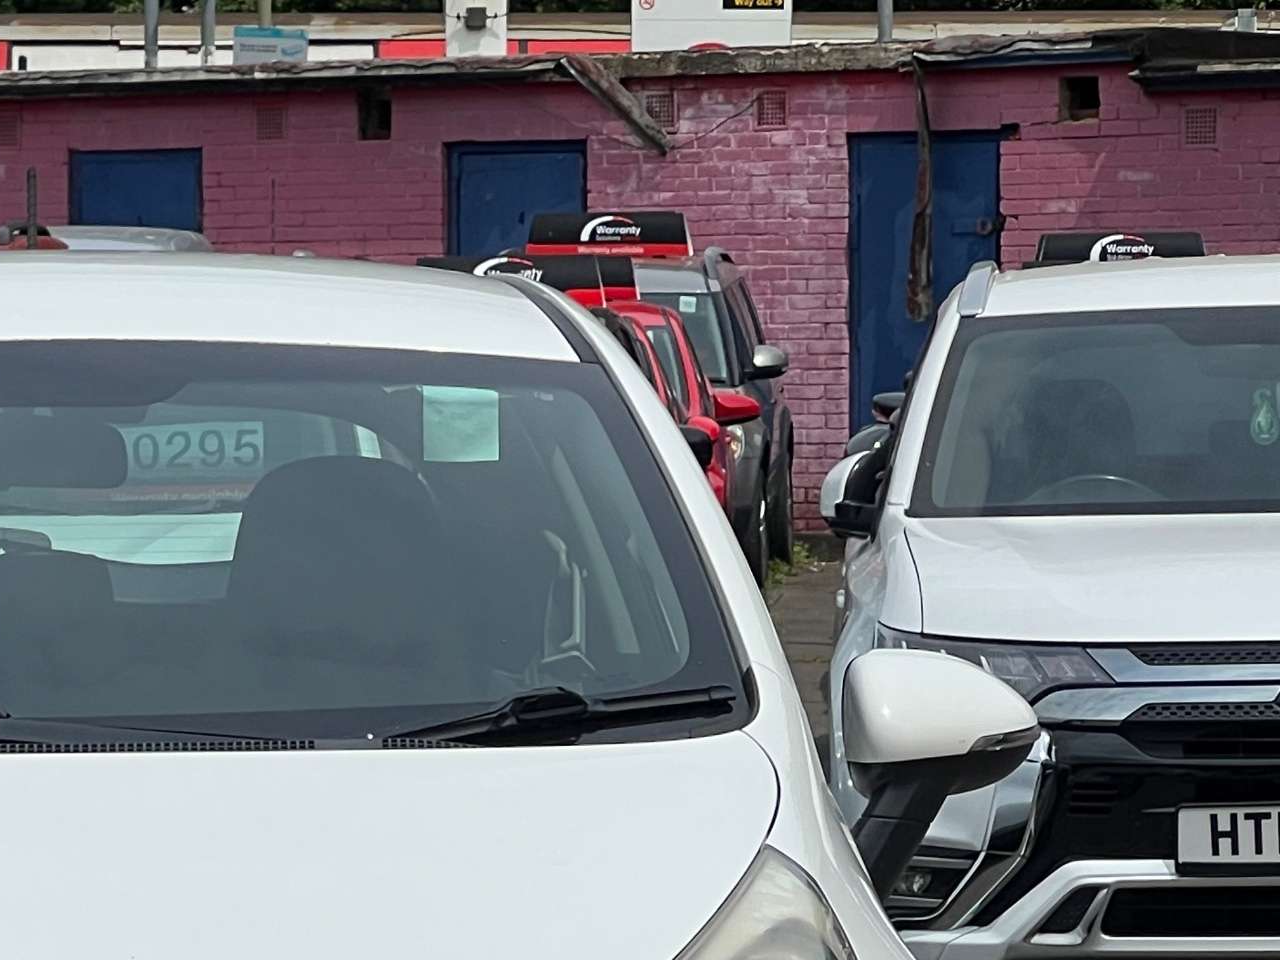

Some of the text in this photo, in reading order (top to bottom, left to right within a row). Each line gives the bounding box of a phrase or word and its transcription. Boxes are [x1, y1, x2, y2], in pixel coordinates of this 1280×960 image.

[596, 225, 641, 236] Warranty
[1106, 243, 1154, 256] Warranty
[1209, 811, 1280, 856] HT
